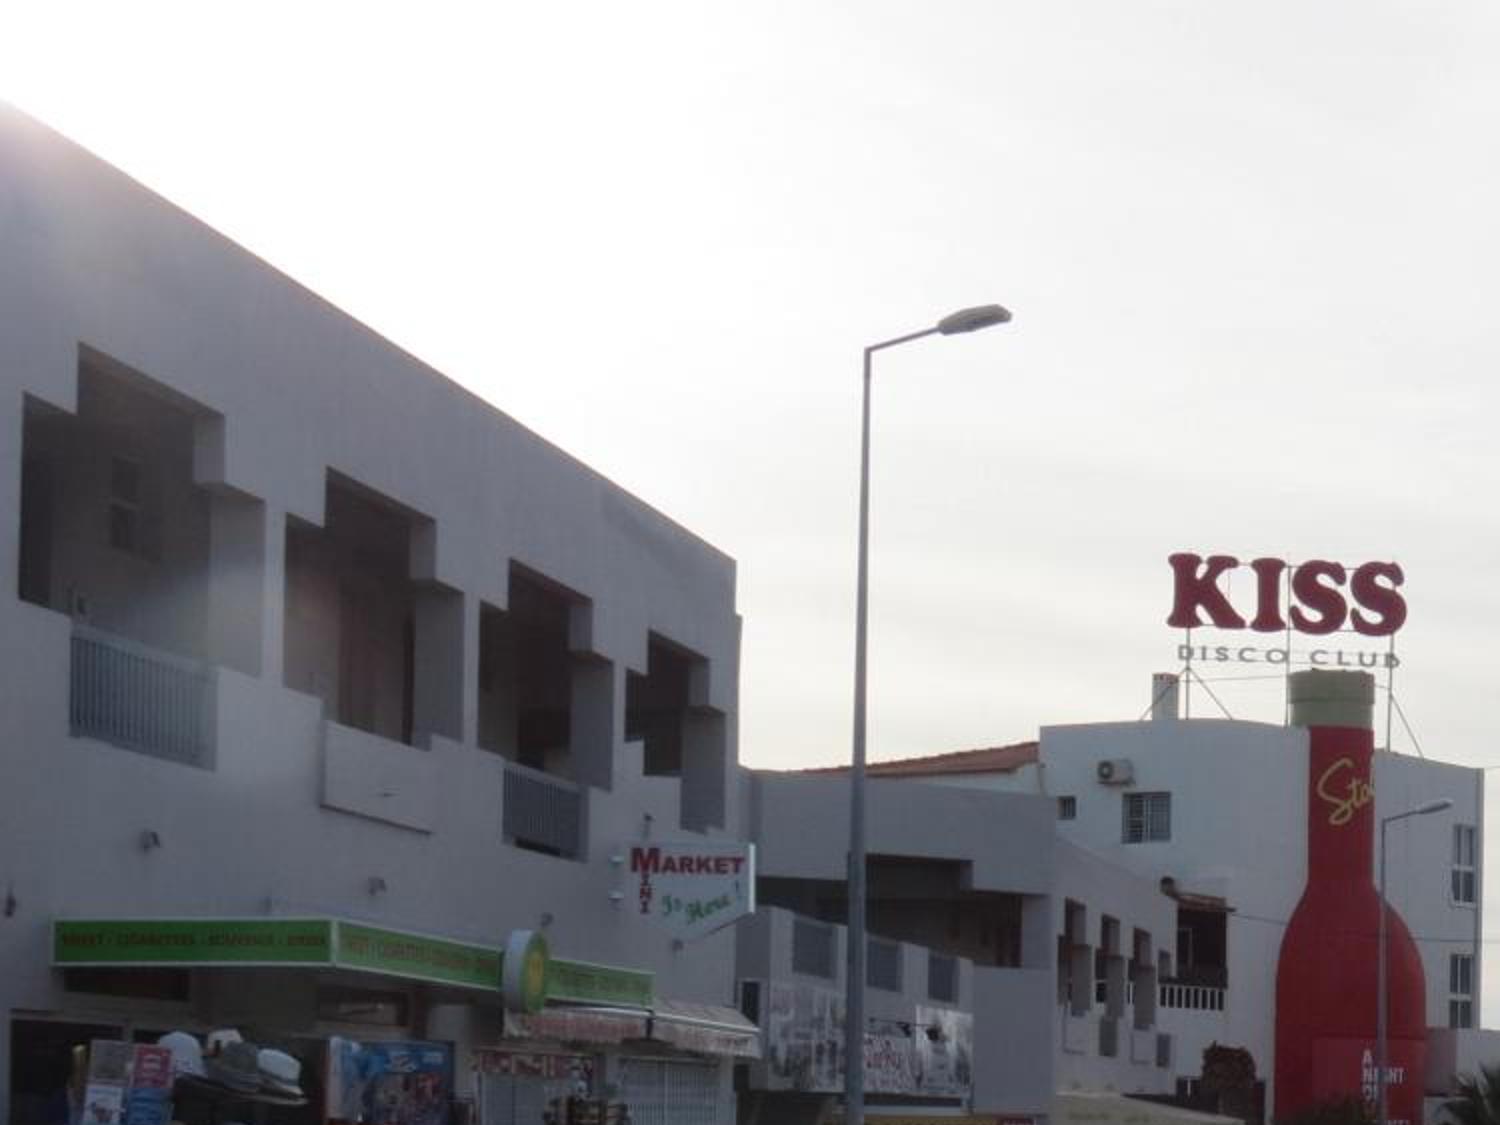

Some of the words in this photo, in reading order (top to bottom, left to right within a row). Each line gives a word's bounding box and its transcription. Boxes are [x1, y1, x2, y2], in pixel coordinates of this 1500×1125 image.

[1167, 552, 1408, 637] KISS
[1178, 644, 1288, 664] DISCO
[1310, 648, 1401, 669] CLUB
[631, 847, 745, 875] MARKET
